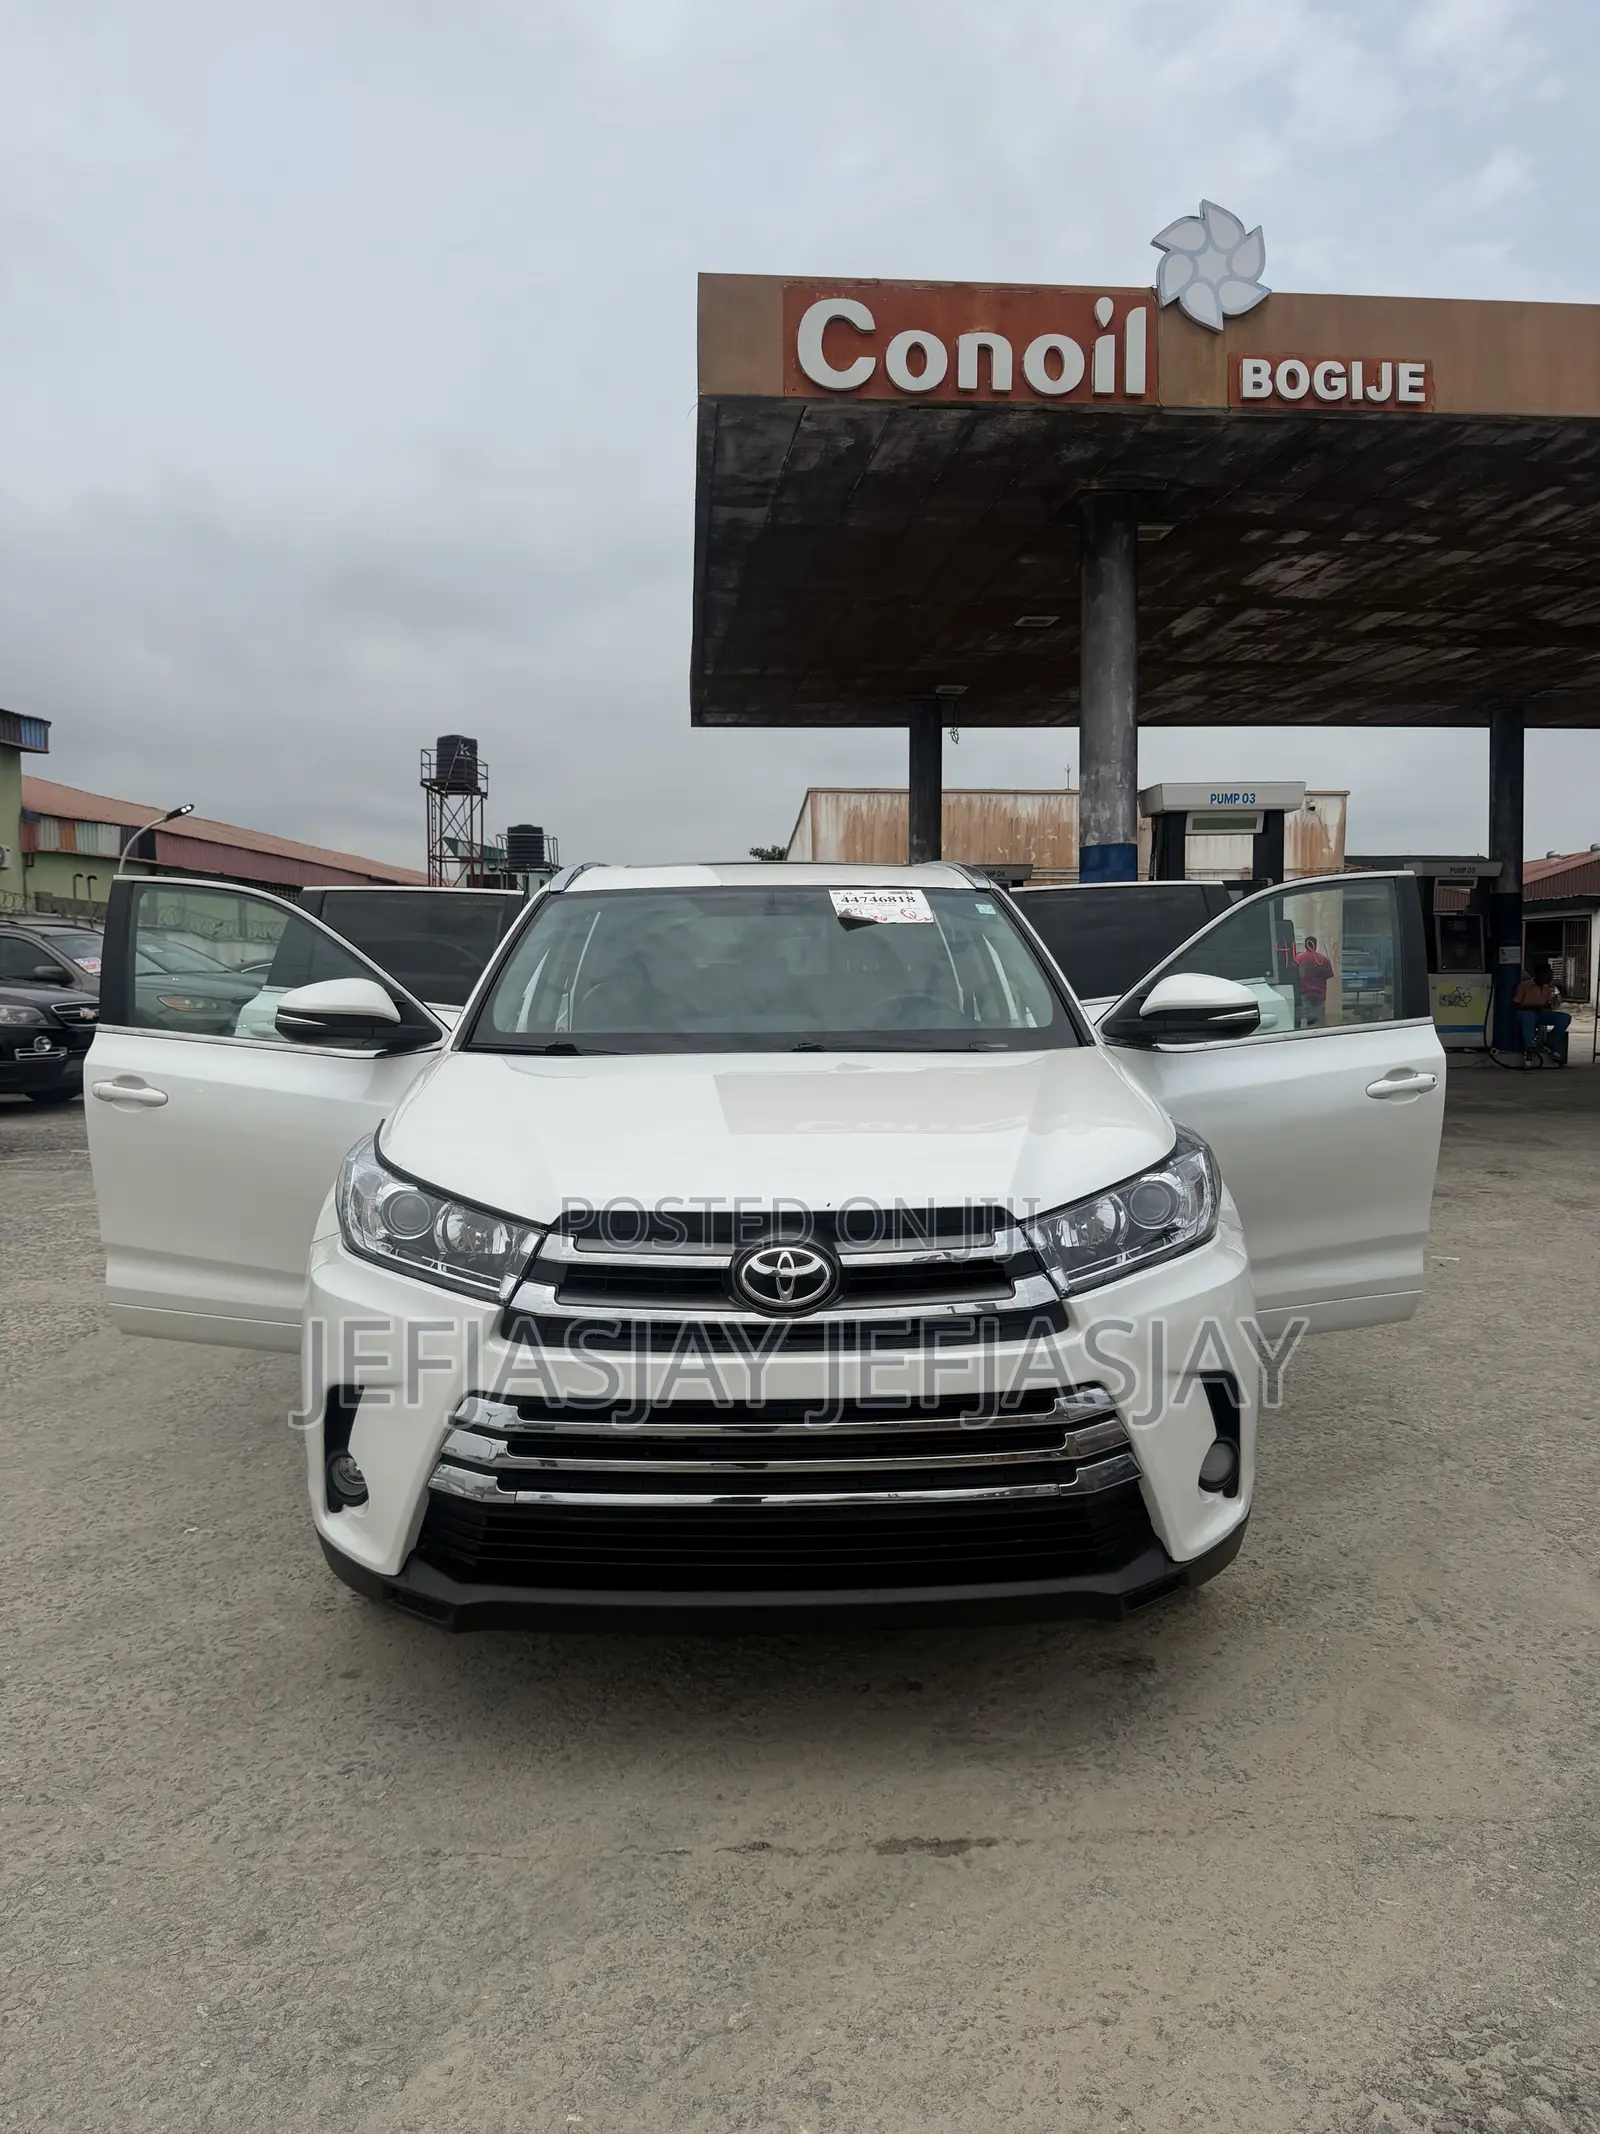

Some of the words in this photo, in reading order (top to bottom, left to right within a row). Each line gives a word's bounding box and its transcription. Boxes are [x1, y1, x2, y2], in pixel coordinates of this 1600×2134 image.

[796, 297, 1147, 396] Conoil
[1240, 358, 1426, 403] BOGIJE
[1210, 793, 1240, 804] PUMP
[1241, 793, 1256, 804] 03
[841, 895, 916, 903] 44746818
